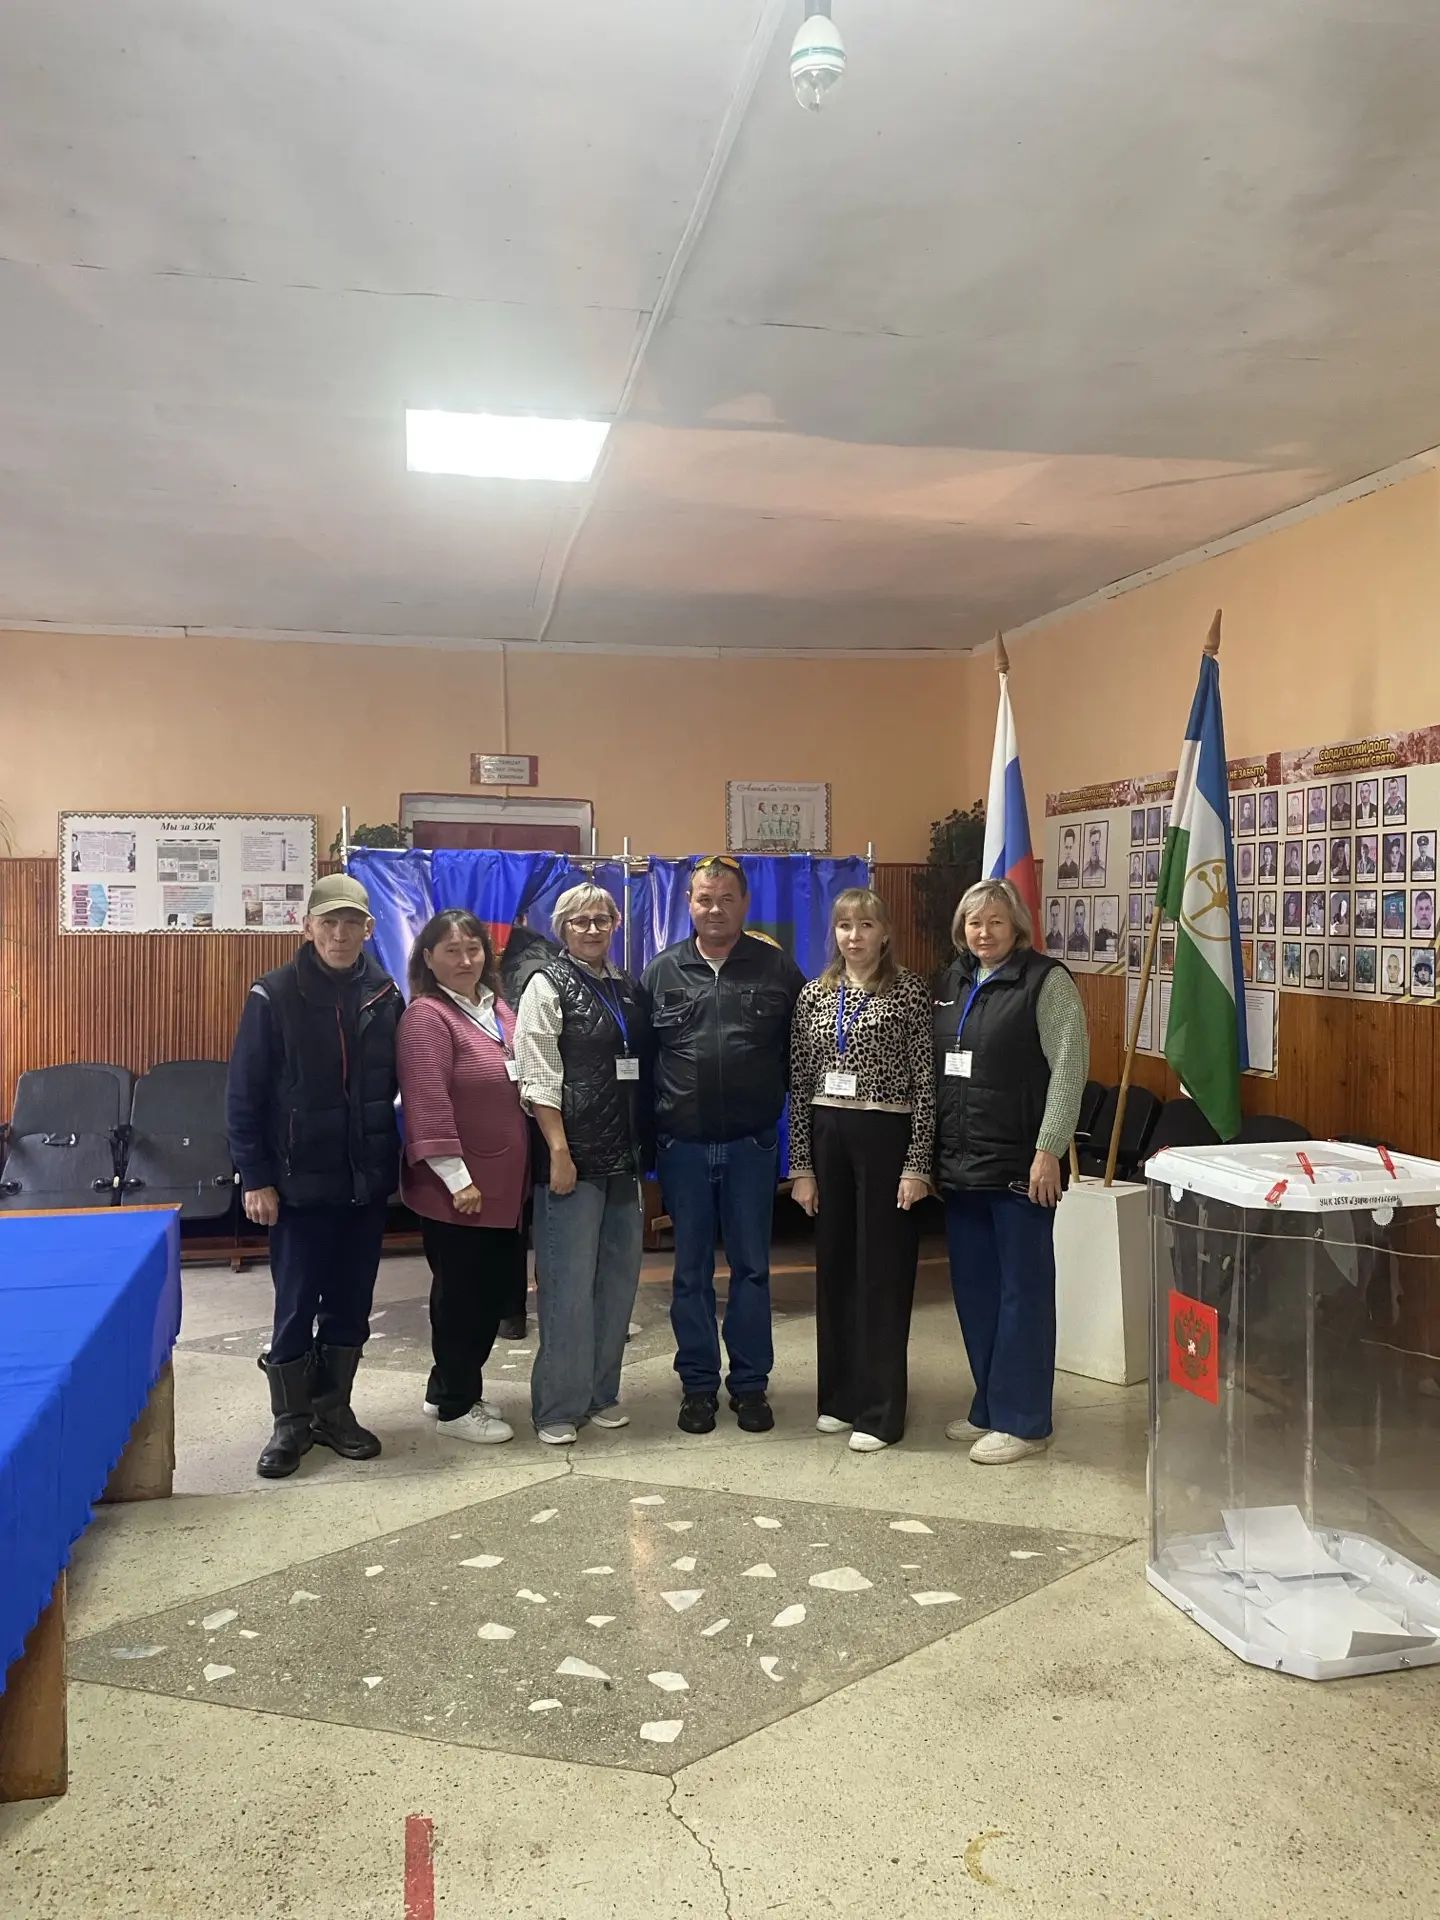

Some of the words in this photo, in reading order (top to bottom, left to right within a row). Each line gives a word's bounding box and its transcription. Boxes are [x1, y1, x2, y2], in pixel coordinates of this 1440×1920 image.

[1319, 740, 1367, 761] СОЛДАТСКИЙ
[1368, 738, 1390, 754] ДОЛГ
[1313, 759, 1352, 775] ИСПОЛНЕН
[1352, 757, 1370, 770] ИМИ
[1371, 752, 1397, 766] СВЯТО
[1229, 770, 1238, 780] НЕ
[1238, 765, 1265, 779] ЗАБЫТО
[160, 822, 177, 831] Мы
[192, 822, 216, 831] ЗОЖ
[183, 1138, 190, 1146] 3
[1319, 1198, 1334, 1206] УИК
